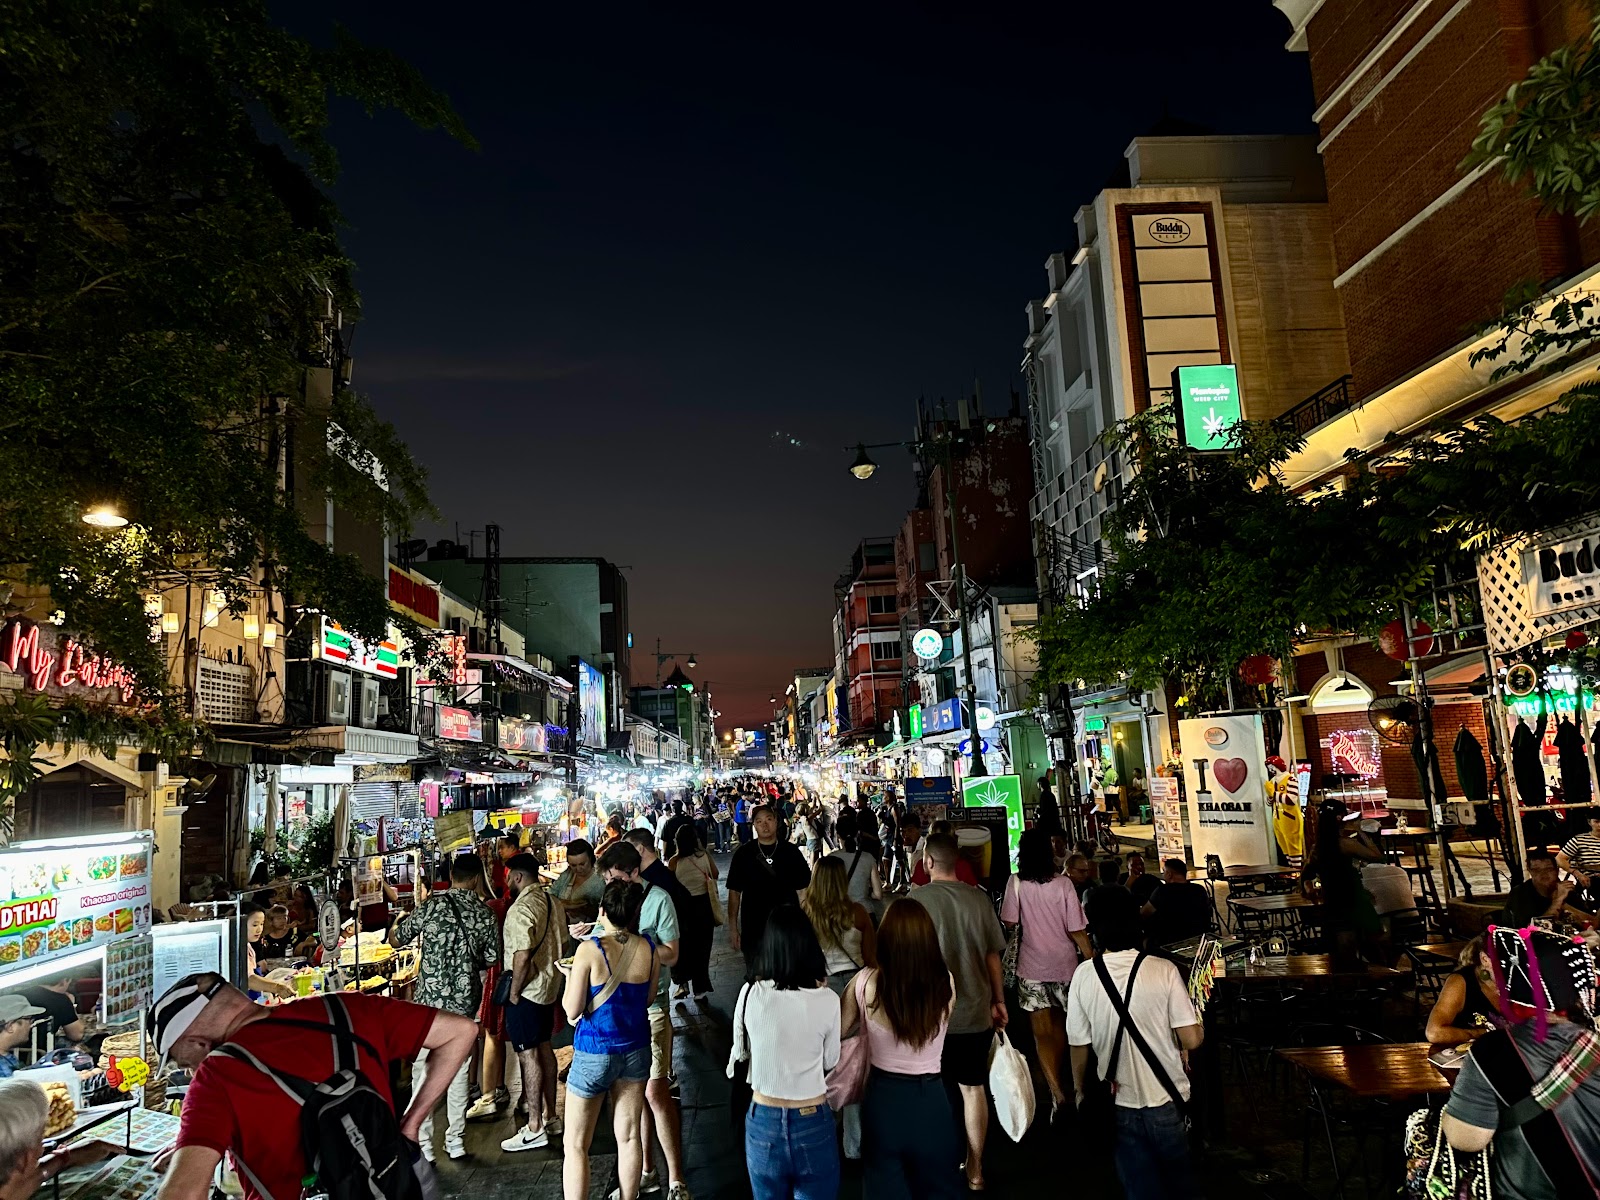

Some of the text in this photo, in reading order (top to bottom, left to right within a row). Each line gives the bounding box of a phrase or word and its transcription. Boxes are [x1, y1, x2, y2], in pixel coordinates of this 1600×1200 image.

[1156, 222, 1183, 234] Buddy
[11, 621, 55, 692] My
[454, 635, 466, 684] TATTOO
[1197, 802, 1253, 812] KHAOSAN
[80, 884, 147, 909] Khaosan original
[0, 897, 57, 931] DTHAI
